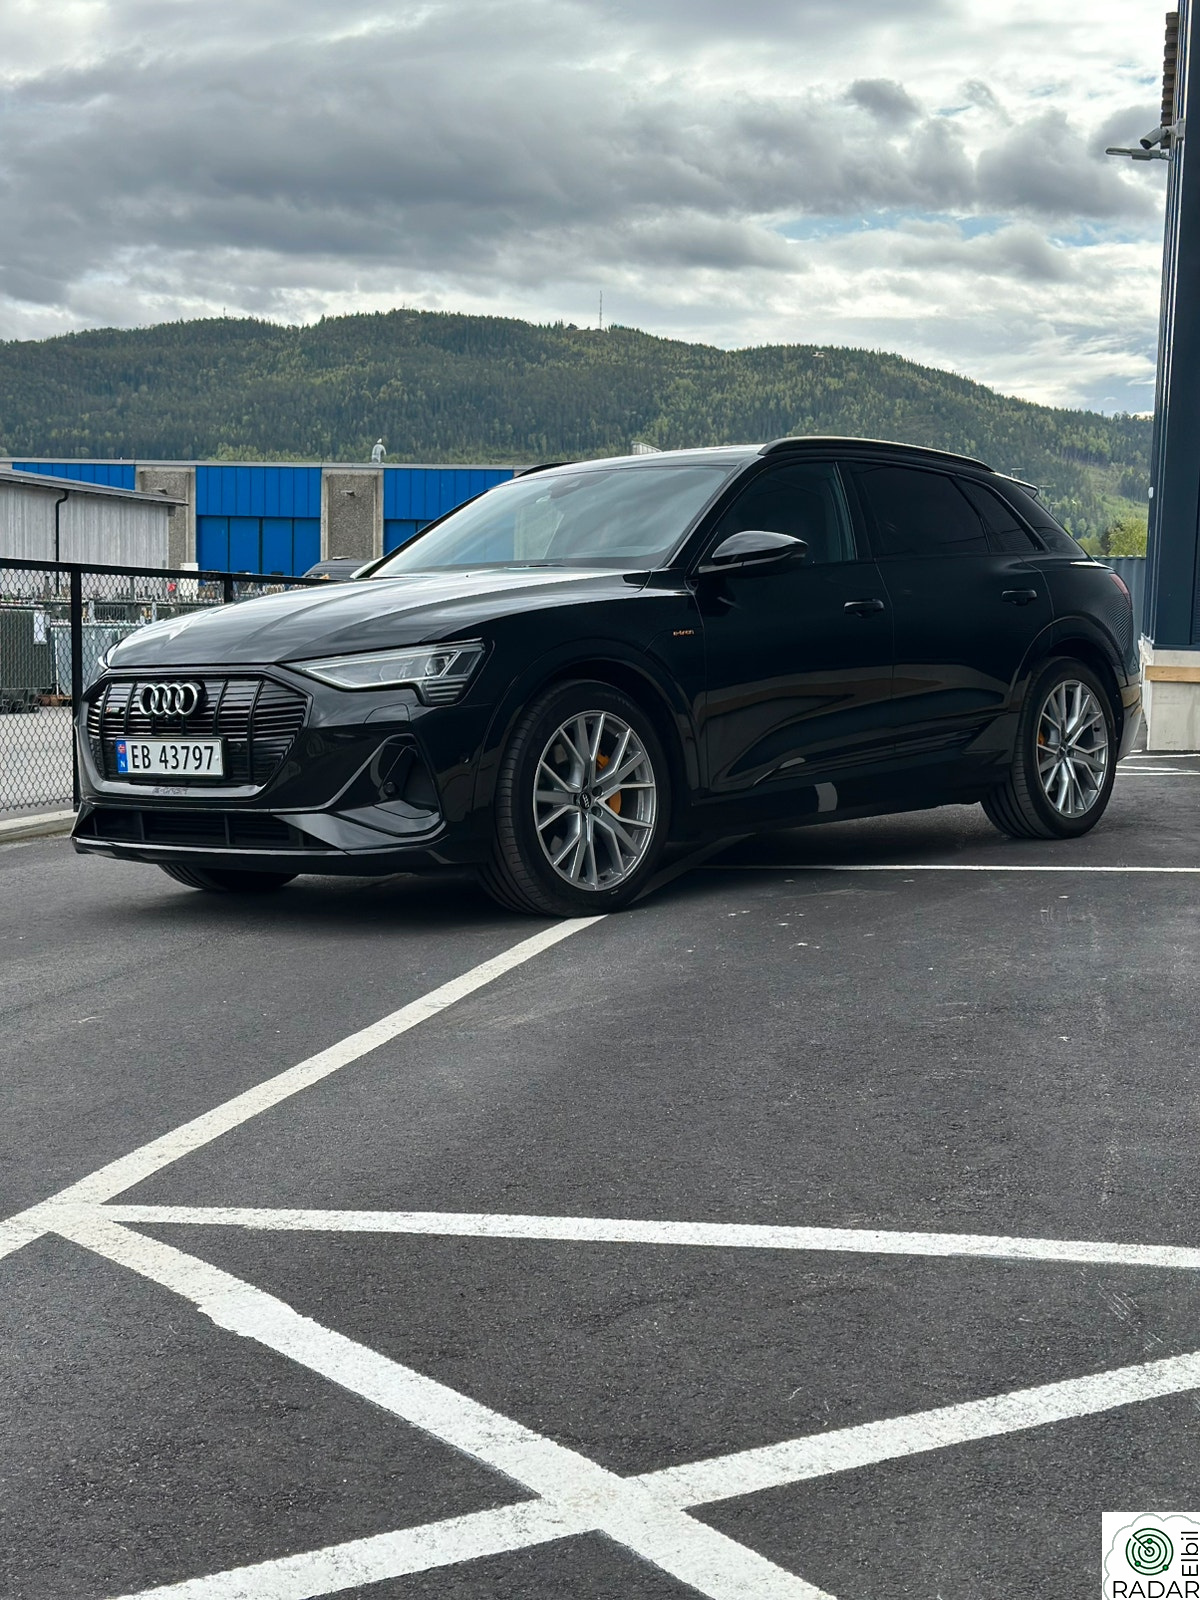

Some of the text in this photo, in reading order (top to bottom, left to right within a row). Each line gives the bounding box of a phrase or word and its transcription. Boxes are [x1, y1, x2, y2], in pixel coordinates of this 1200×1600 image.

[120, 760, 126, 768] N
[130, 745, 214, 770] EB 43797
